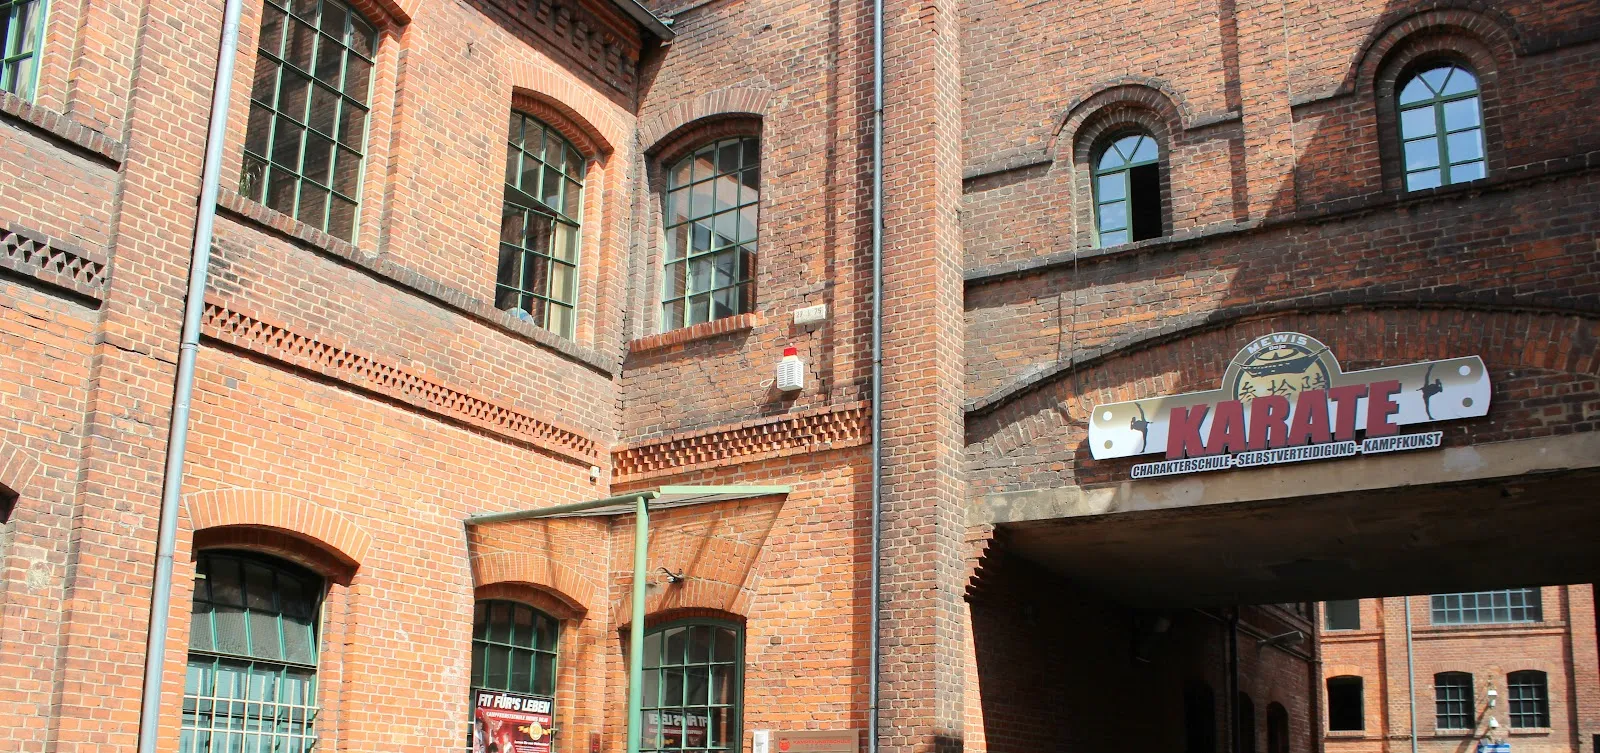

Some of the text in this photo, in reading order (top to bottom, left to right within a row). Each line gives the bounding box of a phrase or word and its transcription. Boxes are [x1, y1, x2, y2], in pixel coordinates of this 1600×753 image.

[1247, 334, 1307, 354] MEWIS
[1165, 379, 1401, 460] KARATE
[1133, 457, 1230, 477] CHARAKTERSCHULE
[1238, 442, 1354, 466] SELBSTVERTEIDIGUNG
[1363, 432, 1441, 452] KAMPFKUNST
[478, 693, 550, 713] FIT FÜR'S LEBEN
